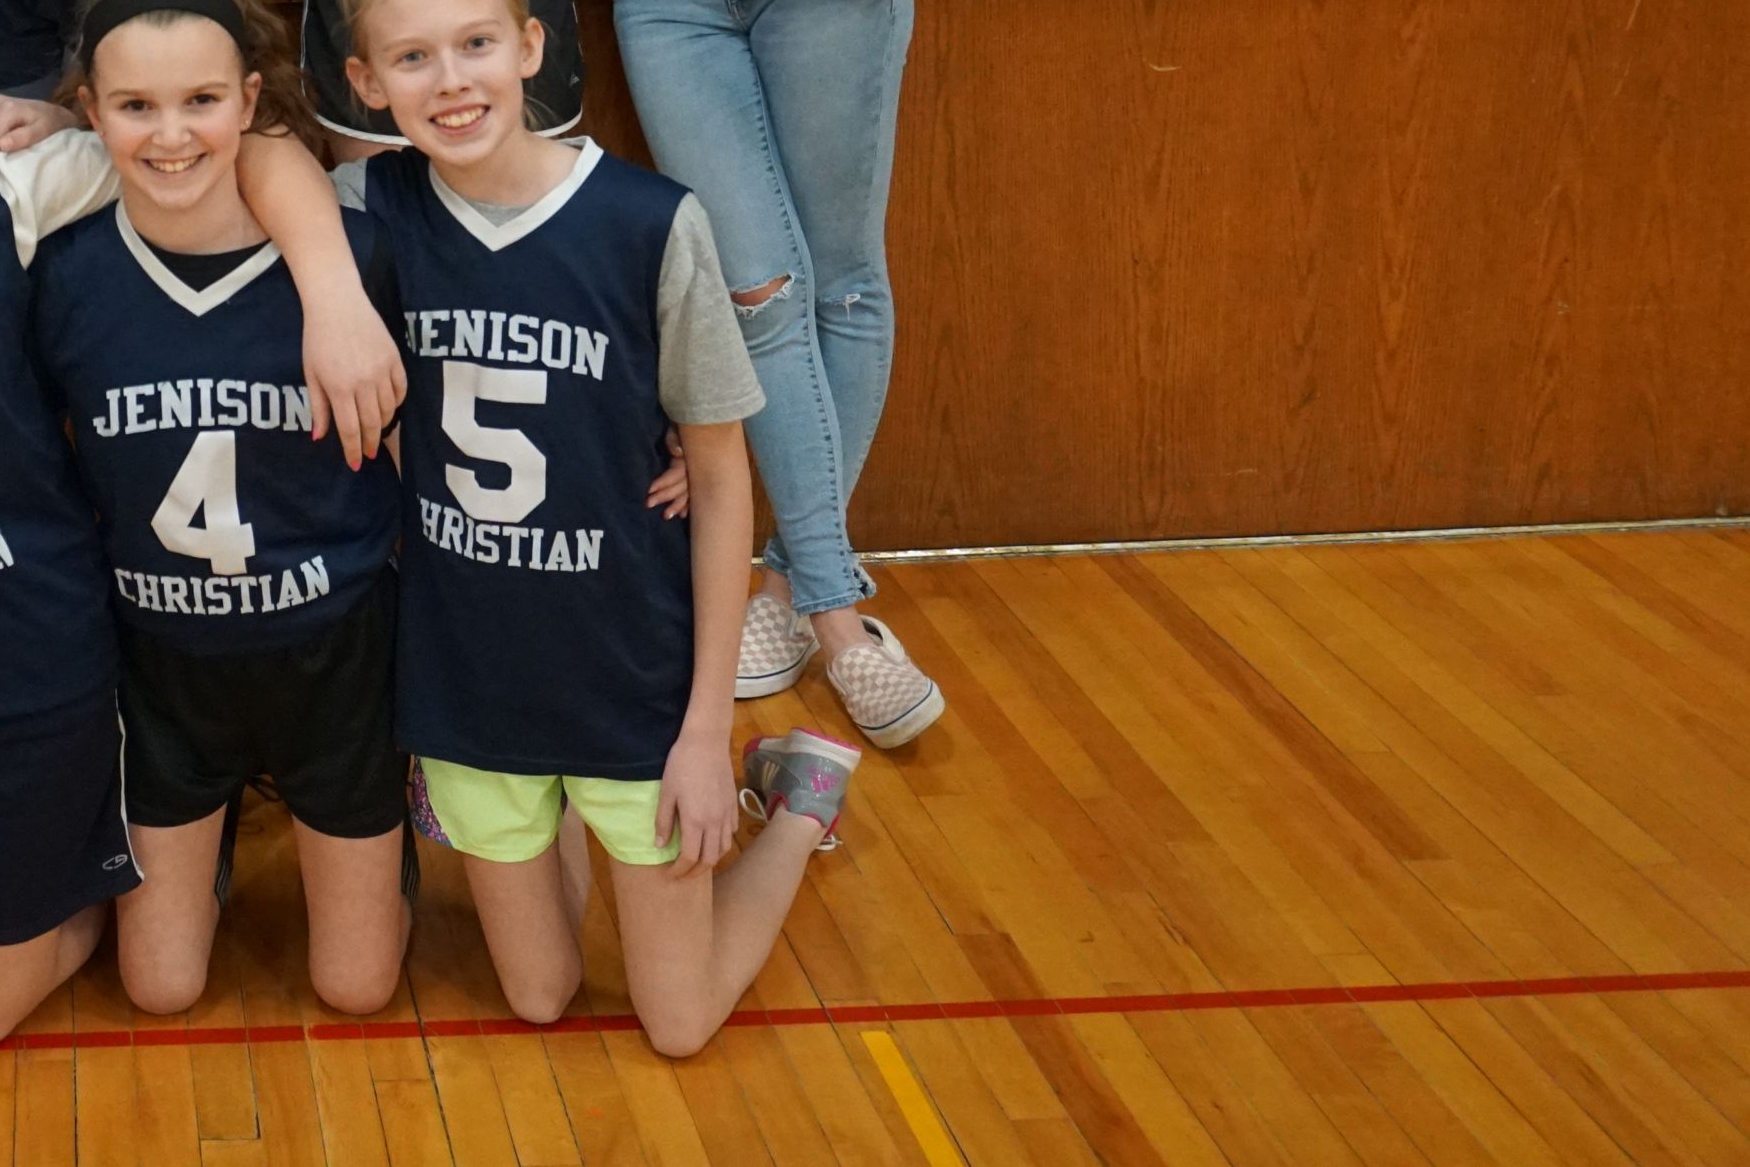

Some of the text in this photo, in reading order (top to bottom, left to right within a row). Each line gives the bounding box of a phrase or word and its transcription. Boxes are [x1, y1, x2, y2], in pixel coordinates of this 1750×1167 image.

[93, 378, 314, 437] JENISON
[441, 360, 548, 523] 5
[151, 430, 256, 574] 4
[416, 493, 604, 572] HRISTIAN
[114, 555, 330, 615] CHRISTIAN
